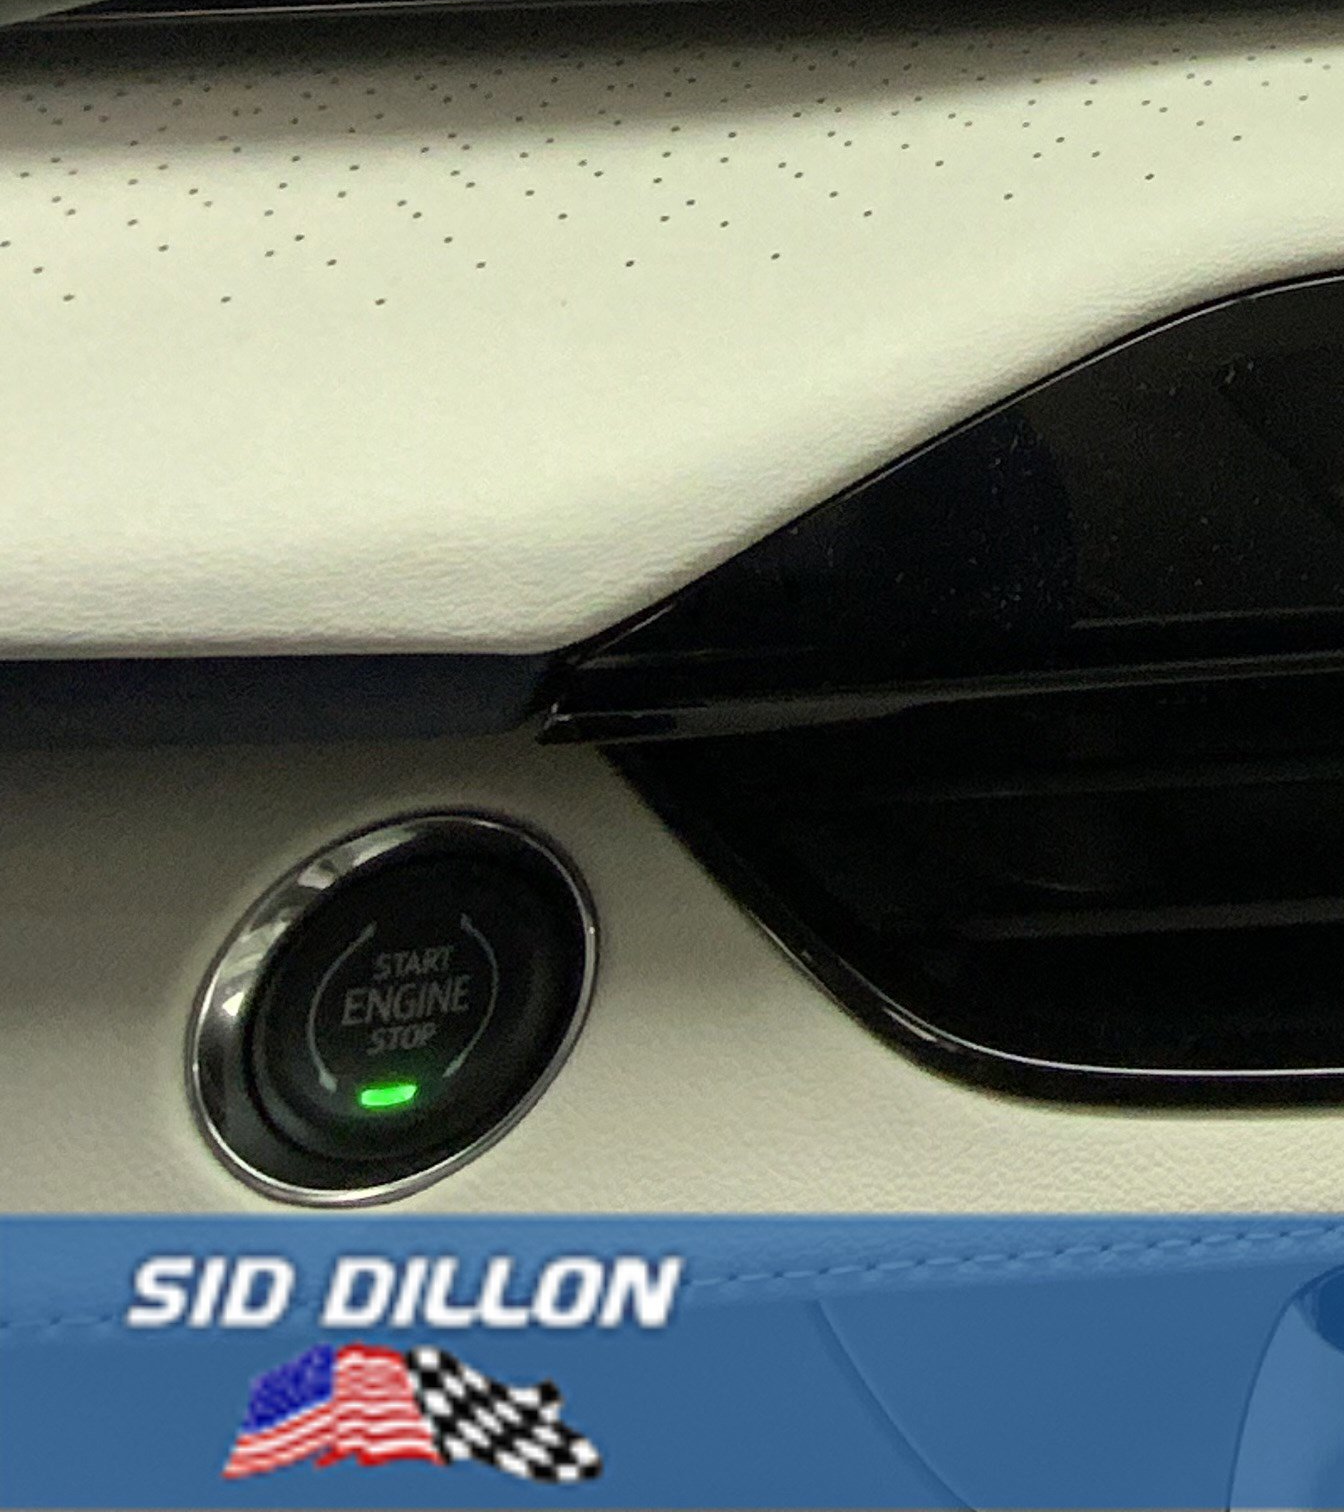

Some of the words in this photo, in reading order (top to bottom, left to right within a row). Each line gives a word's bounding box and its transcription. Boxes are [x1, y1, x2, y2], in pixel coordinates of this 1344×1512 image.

[373, 946, 454, 981] START
[341, 975, 471, 1027] ENGINE
[367, 1023, 438, 1056] STOP
